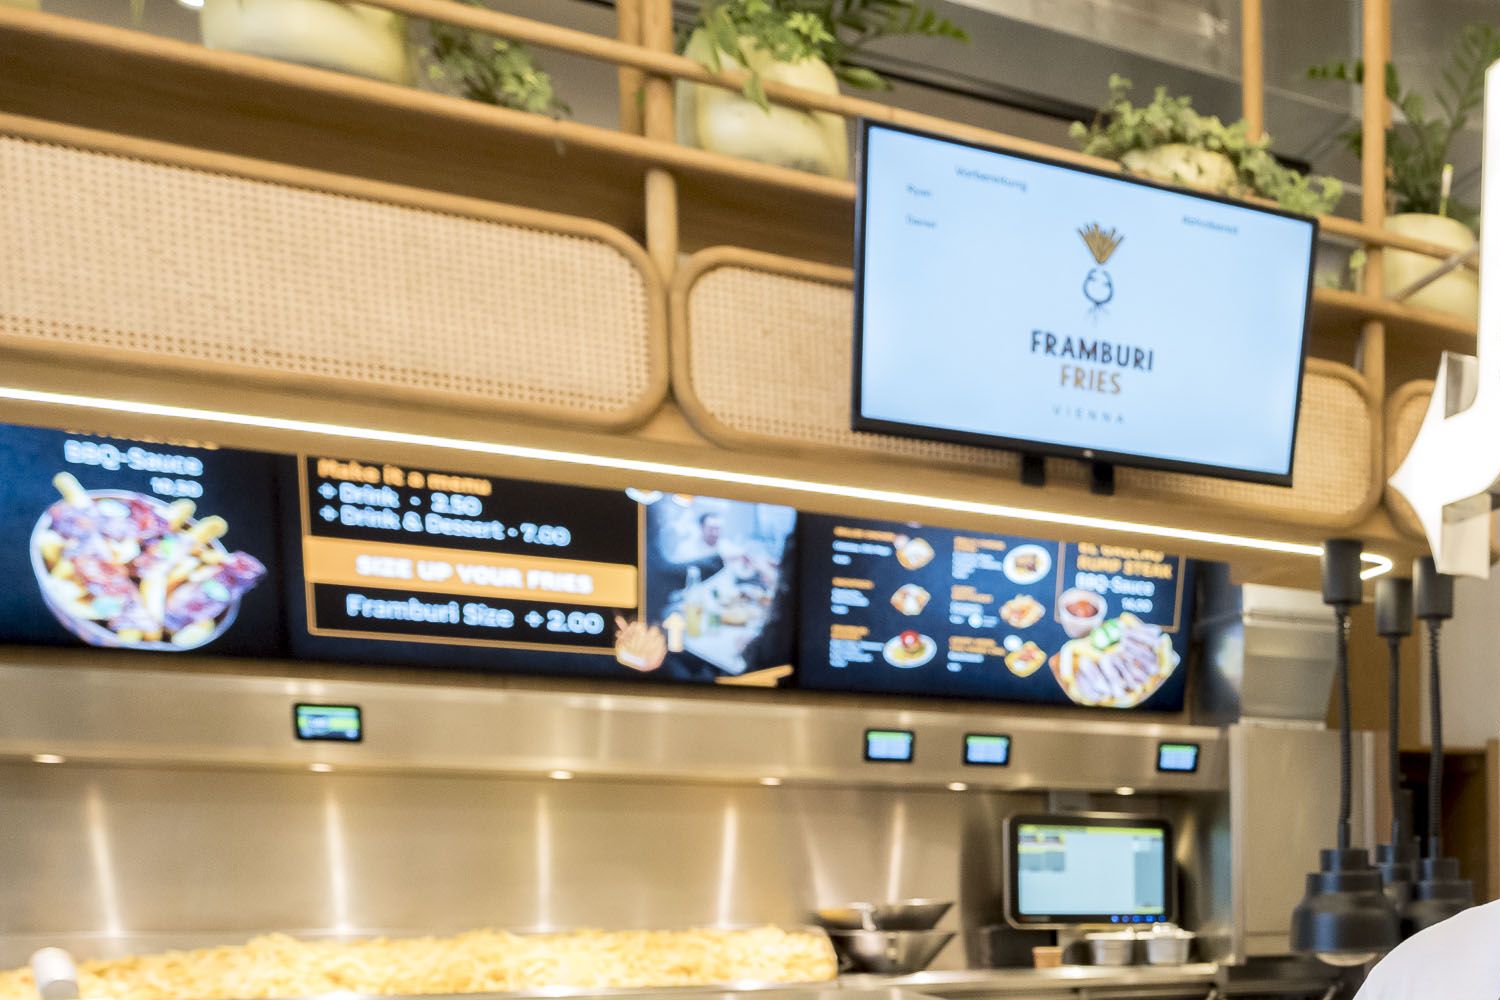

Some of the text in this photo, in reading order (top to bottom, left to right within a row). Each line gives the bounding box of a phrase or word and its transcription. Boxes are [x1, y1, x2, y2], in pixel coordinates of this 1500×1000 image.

[1031, 329, 1155, 372] FRAMBURI
[1060, 364, 1121, 395] FRIES
[1053, 405, 1126, 425] VIENNA
[64, 439, 204, 476] BBQ-Sauce
[339, 482, 400, 509] Drink
[430, 492, 483, 517] 2.50
[340, 504, 401, 531] Drink
[424, 512, 505, 541] Dessert
[519, 522, 572, 547] 7.00
[355, 554, 595, 595] SIZE UP YOUR FRIES
[346, 593, 460, 625] Framburi
[461, 602, 515, 629] Size
[546, 609, 605, 635] 2.00
